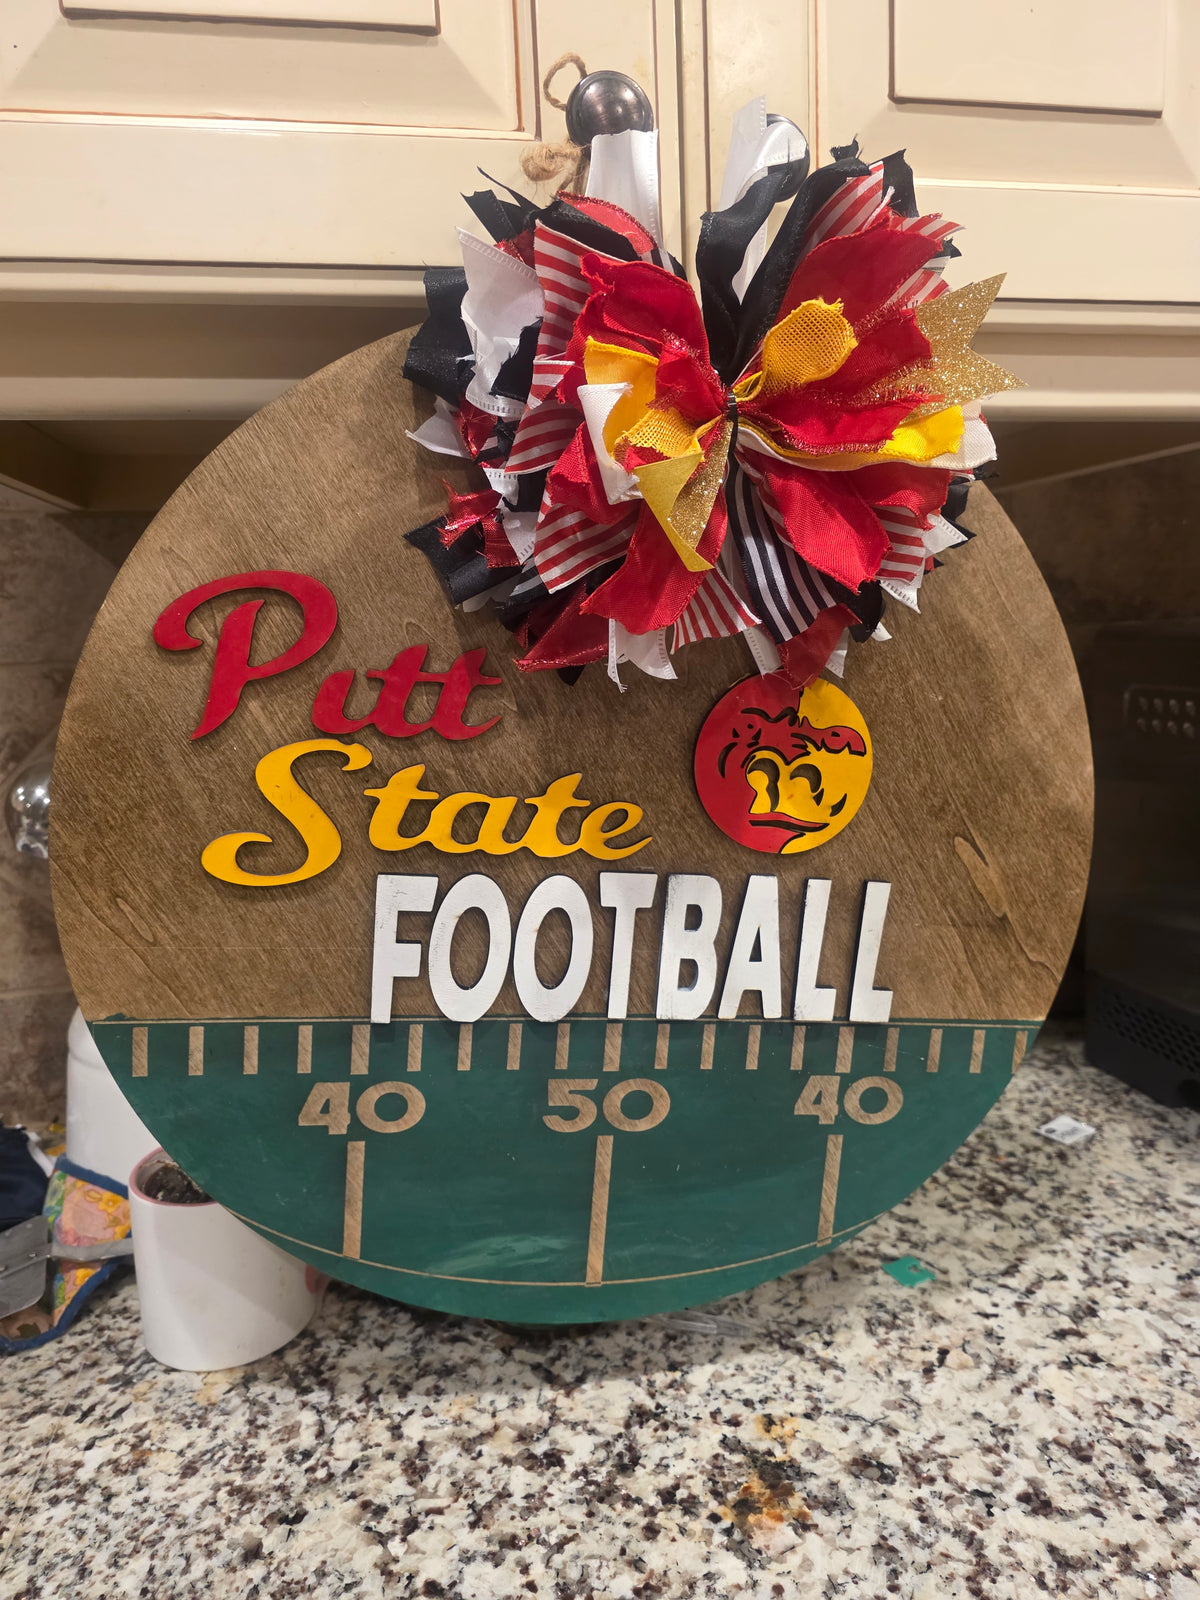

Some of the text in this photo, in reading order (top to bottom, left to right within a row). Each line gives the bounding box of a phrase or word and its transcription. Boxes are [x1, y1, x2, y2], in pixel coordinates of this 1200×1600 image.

[201, 738, 653, 887] State
[370, 872, 894, 1024] FOOTBALL
[297, 1074, 904, 1136] 40 50 40
